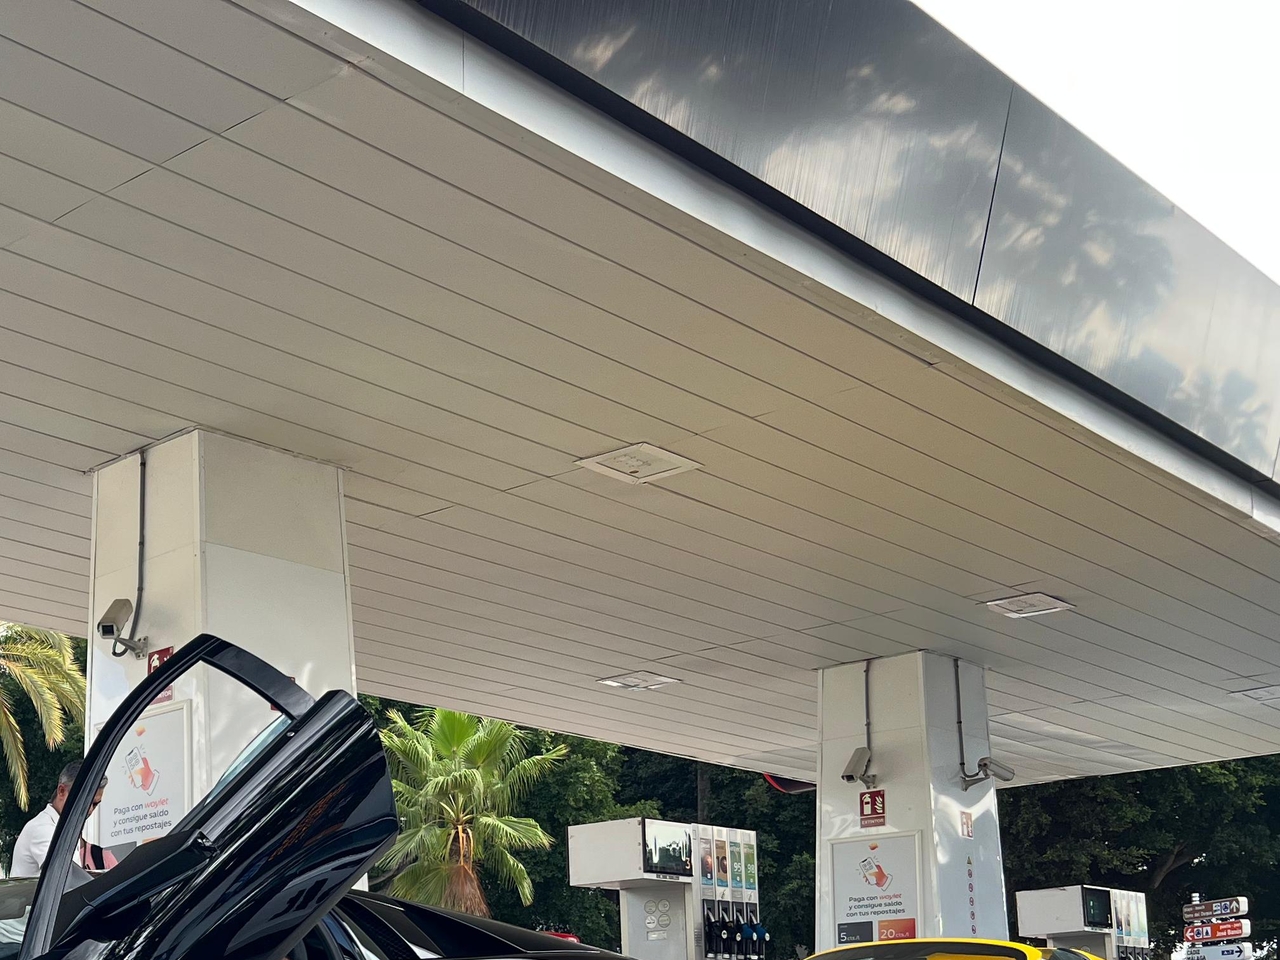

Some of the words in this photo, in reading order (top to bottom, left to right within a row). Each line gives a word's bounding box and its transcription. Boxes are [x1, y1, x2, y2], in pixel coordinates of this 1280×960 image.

[113, 807, 130, 815] Paga
[131, 803, 143, 811] con
[118, 814, 148, 825] consigue
[149, 809, 169, 819] saldo
[110, 830, 122, 838] con
[135, 820, 172, 832] repostajes
[733, 862, 742, 872] 95
[870, 908, 906, 916] repostajes
[840, 932, 847, 942] 5
[880, 929, 896, 939] 20
